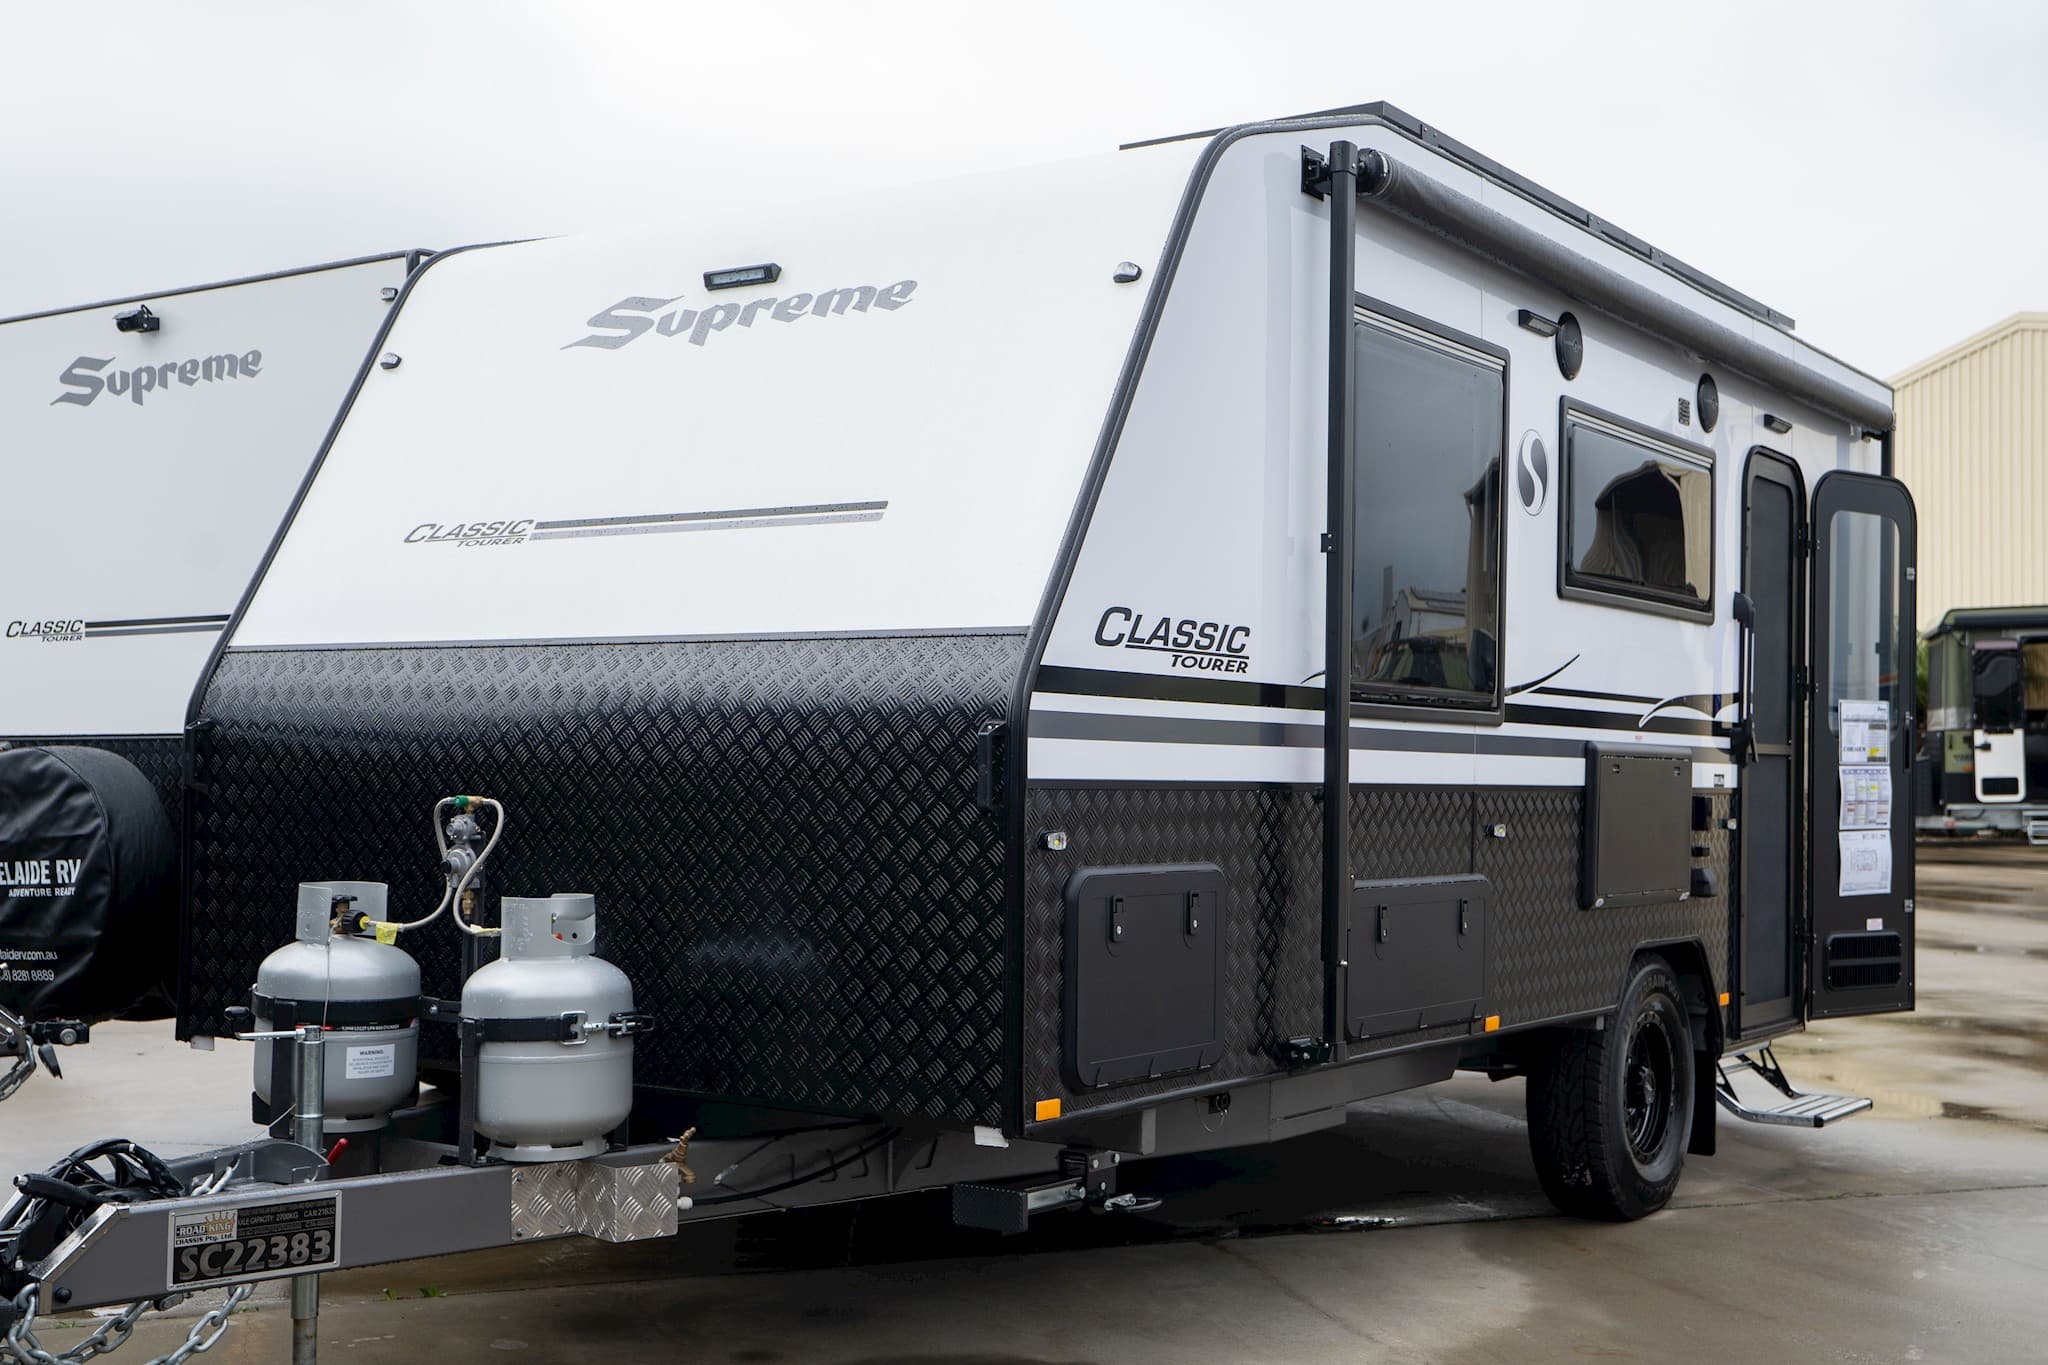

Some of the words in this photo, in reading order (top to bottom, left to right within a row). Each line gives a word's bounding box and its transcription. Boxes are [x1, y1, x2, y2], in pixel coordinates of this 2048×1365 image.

[558, 279, 919, 351] Supreme
[49, 349, 263, 407] Supreme
[456, 537, 525, 548] TOURER
[1094, 606, 1251, 654] CLASSIC
[41, 635, 83, 643] TOURER
[1171, 653, 1249, 674] TOURER
[55, 858, 81, 884] RV
[8, 886, 53, 898] ADVENTURE
[54, 886, 76, 897] READY
[12, 969, 31, 982] 8281
[179, 1225, 206, 1236] ROAD
[208, 1223, 231, 1233] KING
[175, 1235, 204, 1246] CHASSIS
[179, 1230, 331, 1281] SC22383
